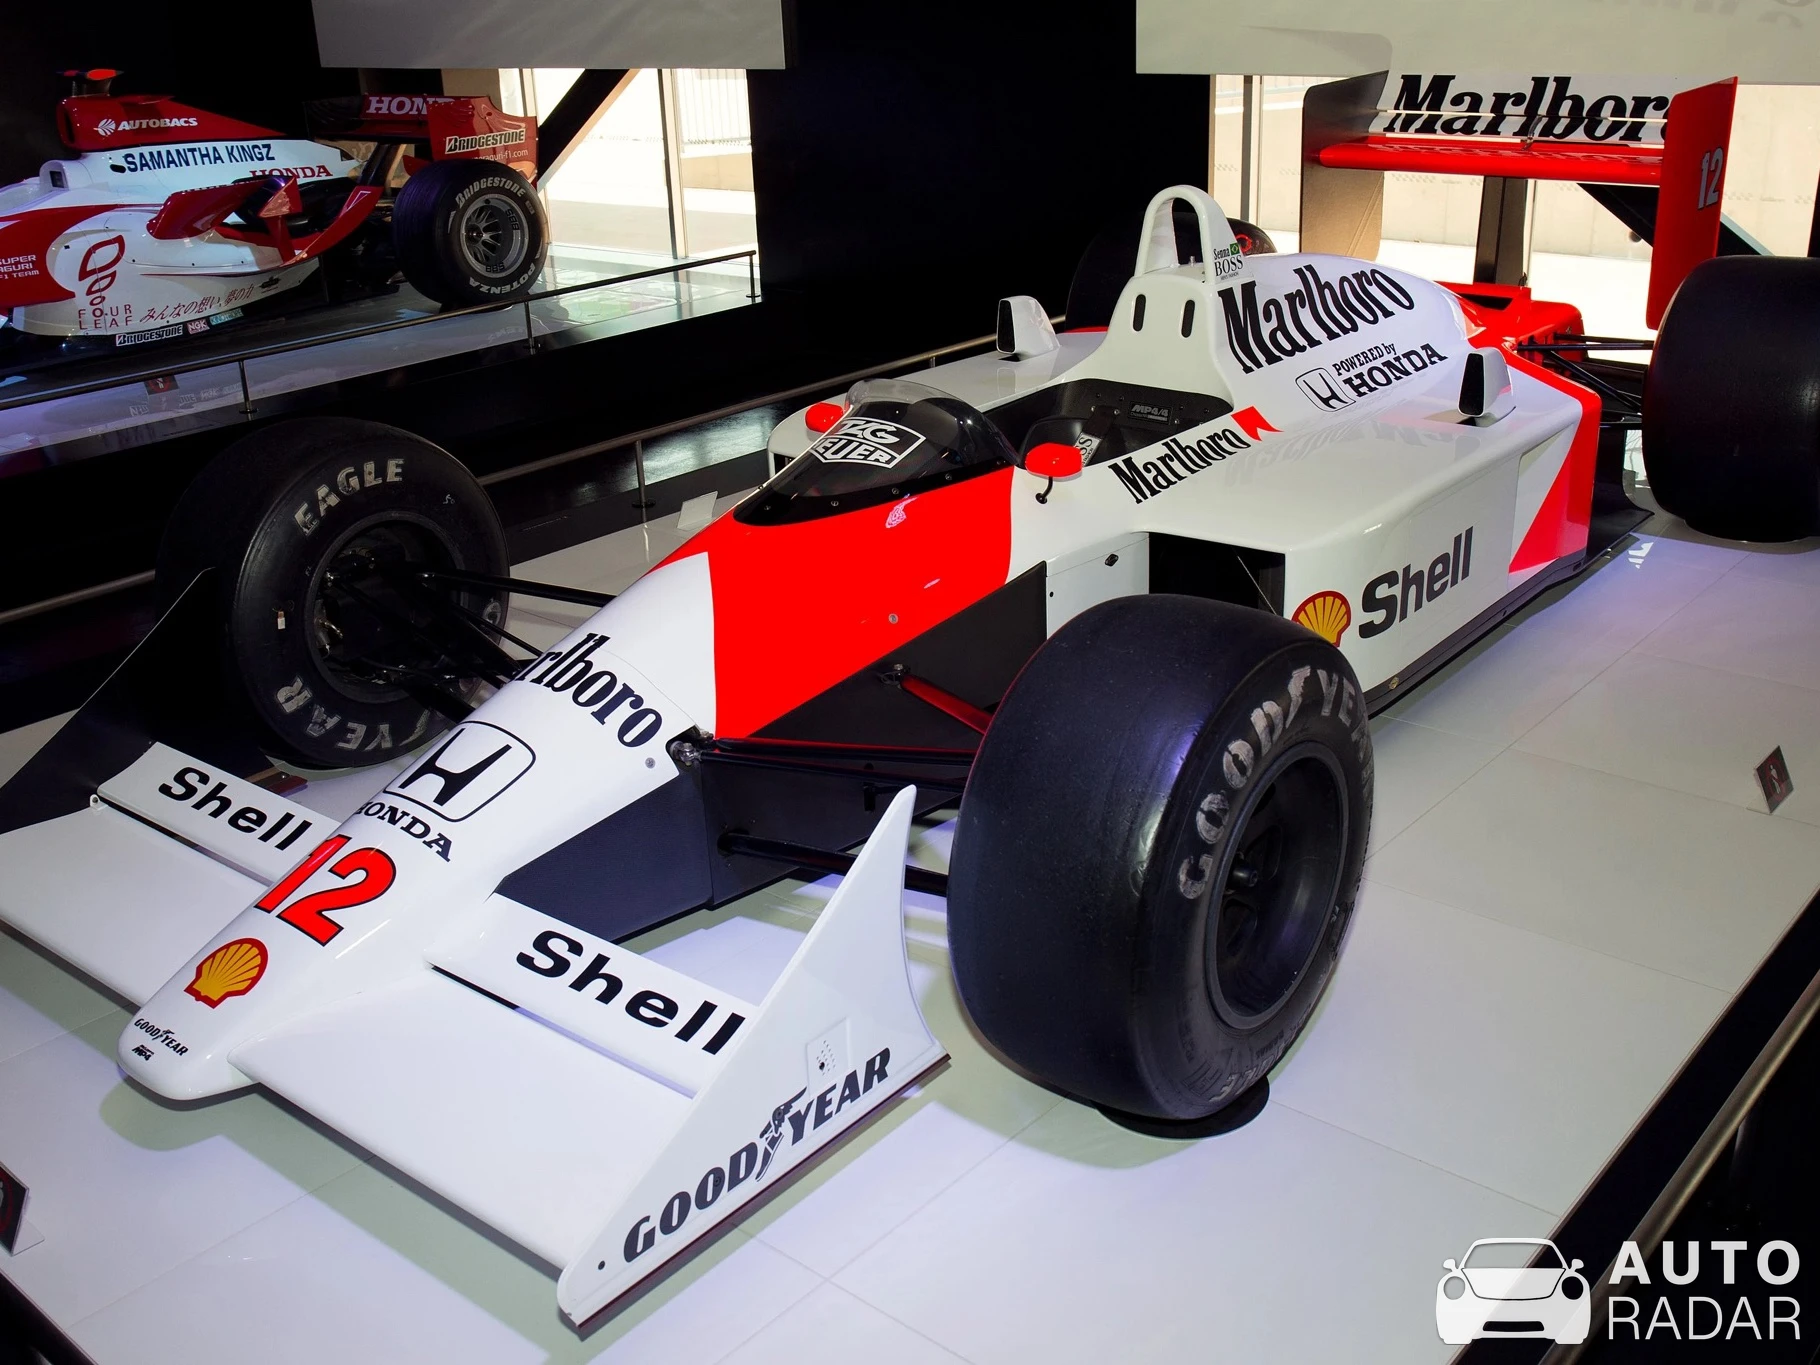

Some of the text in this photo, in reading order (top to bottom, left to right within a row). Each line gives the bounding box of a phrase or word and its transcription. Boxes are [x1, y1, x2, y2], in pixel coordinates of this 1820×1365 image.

[366, 96, 455, 115] HON
[1383, 74, 1670, 142] Marlbor
[117, 117, 198, 131] AUTOBACS
[445, 128, 526, 154] BRIDGESTONE
[123, 143, 276, 173] SAMANTHA KINGZ
[455, 176, 526, 208] BRIDGESTONE
[1697, 147, 1724, 210] 12
[0, 254, 37, 265] UPER
[1213, 247, 1230, 260] Senna
[1214, 255, 1244, 277] BOSS
[469, 262, 536, 294] POTENZA
[78, 303, 132, 320] FOUR
[78, 316, 132, 330] LEAF
[188, 319, 207, 331] NGK
[1217, 264, 1415, 375] Marlboro
[116, 324, 183, 346] BRIDGESTONE
[1332, 343, 1397, 376] POWERED by
[1342, 343, 1448, 397] HONDA
[1108, 428, 1251, 504] Marlboro
[293, 458, 405, 537] EAGLE
[1359, 526, 1473, 639] Shell
[514, 632, 663, 748] rlboro
[158, 766, 313, 851] Shell
[253, 833, 397, 948] 12
[516, 929, 746, 1056] Shell
